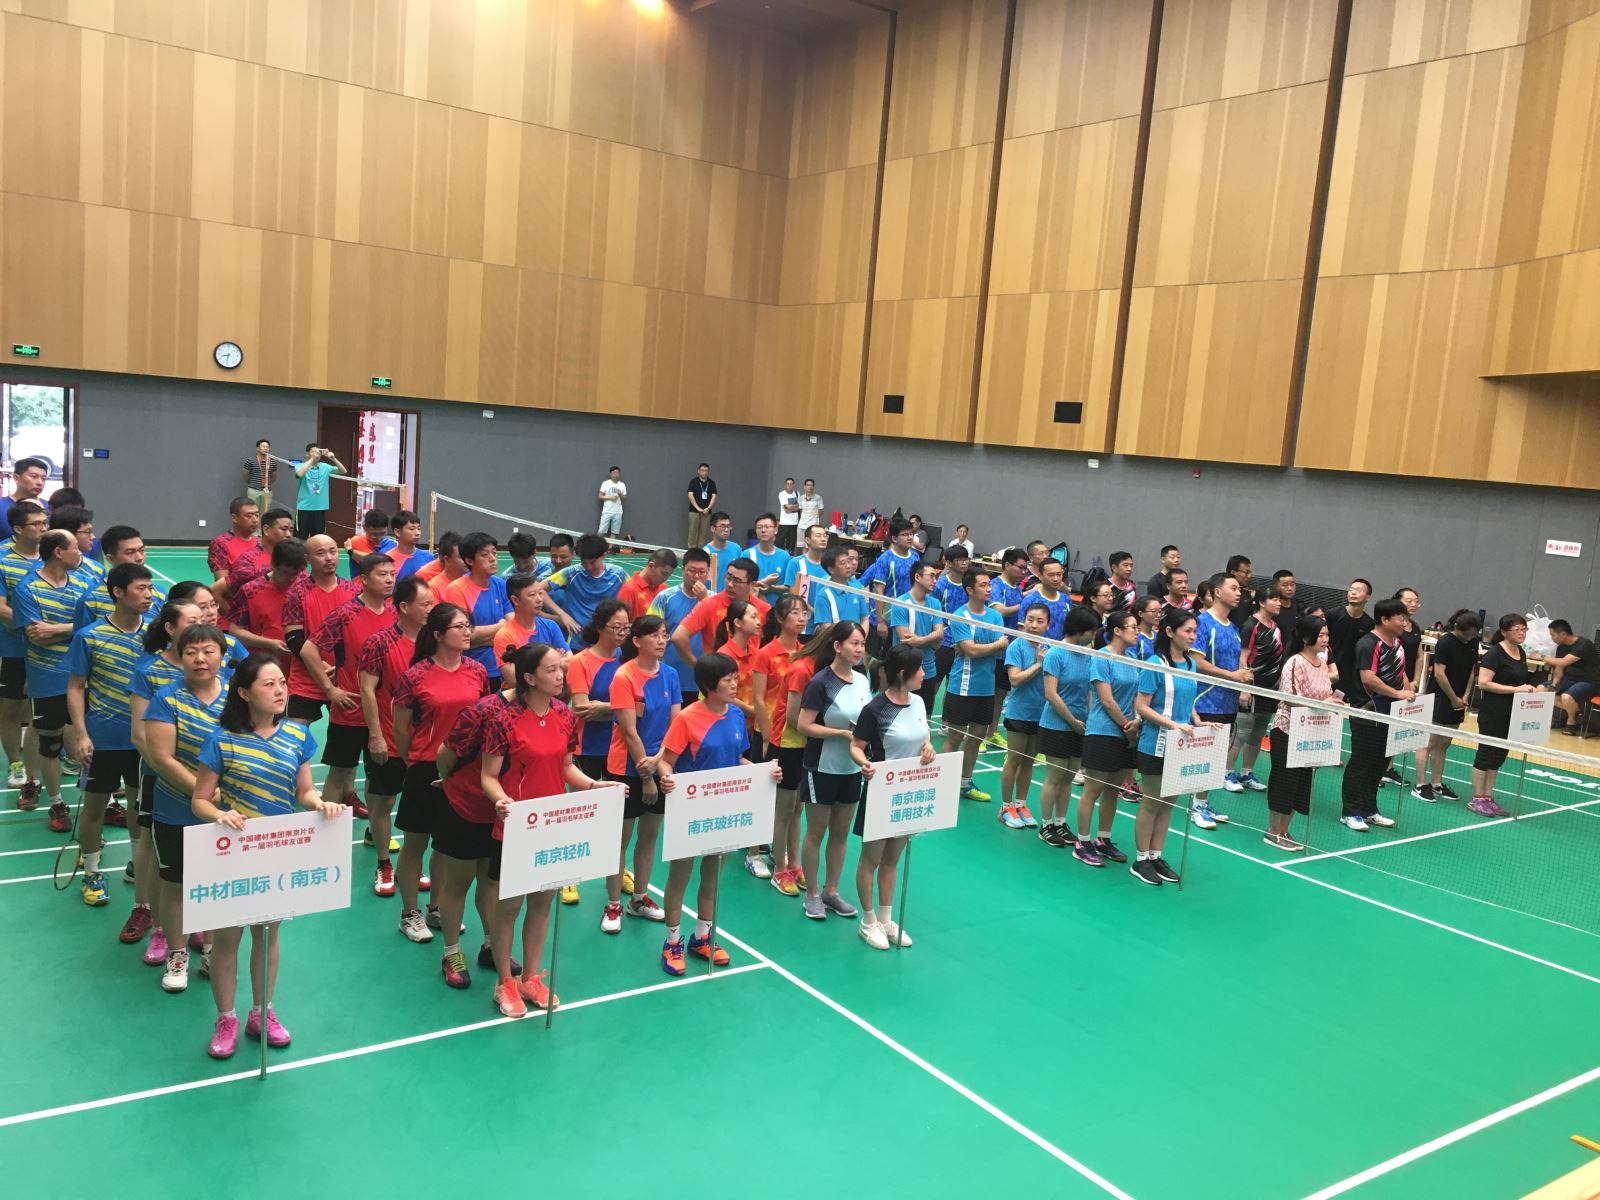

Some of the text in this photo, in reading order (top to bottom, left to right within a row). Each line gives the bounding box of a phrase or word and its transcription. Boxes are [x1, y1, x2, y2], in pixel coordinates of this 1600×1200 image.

[801, 584, 808, 598] 2
[891, 788, 936, 807] 南京商混
[542, 803, 598, 818] 中国建材集团南京片区
[544, 811, 595, 826] 第一届羽毛球友谊赛
[889, 804, 935, 823] 通用技术
[687, 811, 753, 836] 南京玻纤院
[237, 827, 316, 844] 中国建材集团南京片区
[241, 837, 312, 852] 第一届羽毛球友谊赛
[534, 841, 591, 867] 南京轻机
[189, 865, 341, 904] 中材国际（南京）
